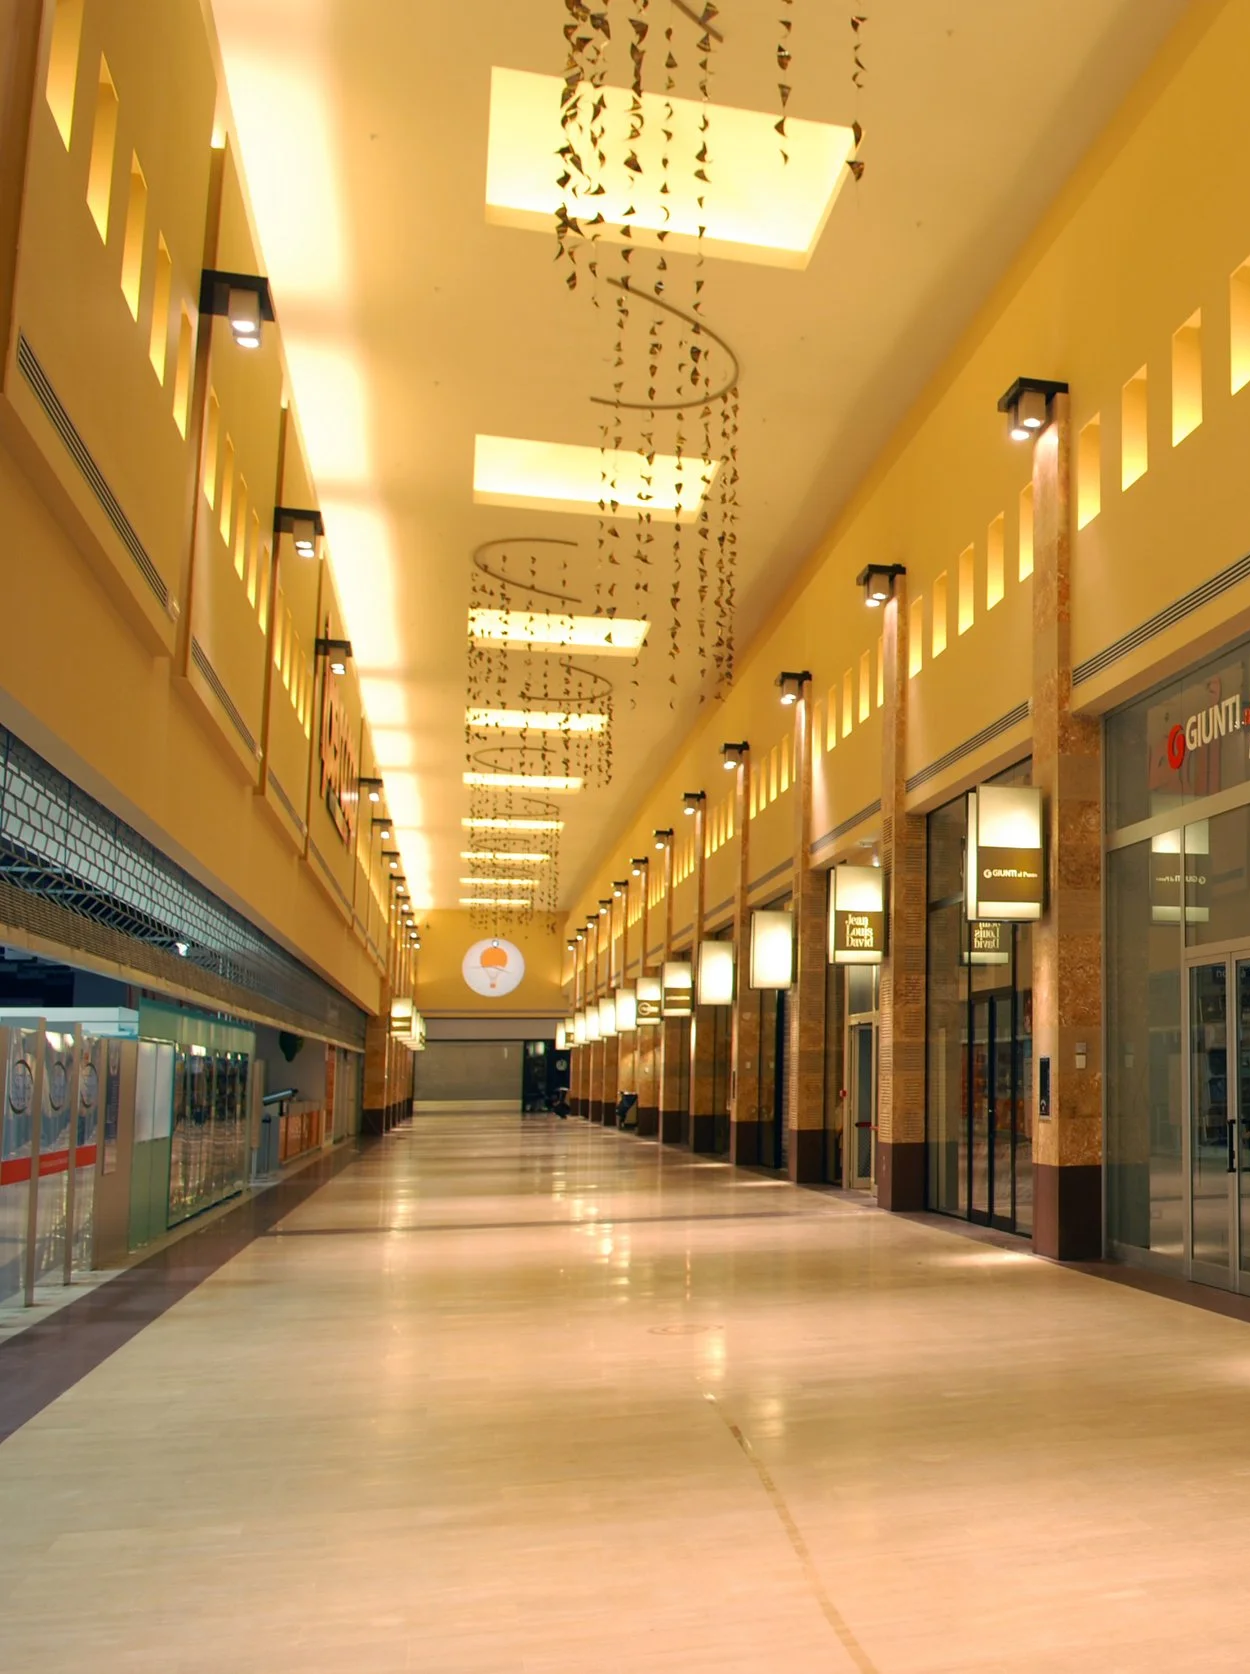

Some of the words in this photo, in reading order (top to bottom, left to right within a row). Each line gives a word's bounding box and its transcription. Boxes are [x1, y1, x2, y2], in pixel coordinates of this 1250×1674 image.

[1185, 694, 1240, 751] GIUNTI
[992, 869, 1018, 878] GIUNTI
[845, 913, 869, 927] Jean
[846, 924, 874, 937] Louis
[846, 935, 874, 948] David
